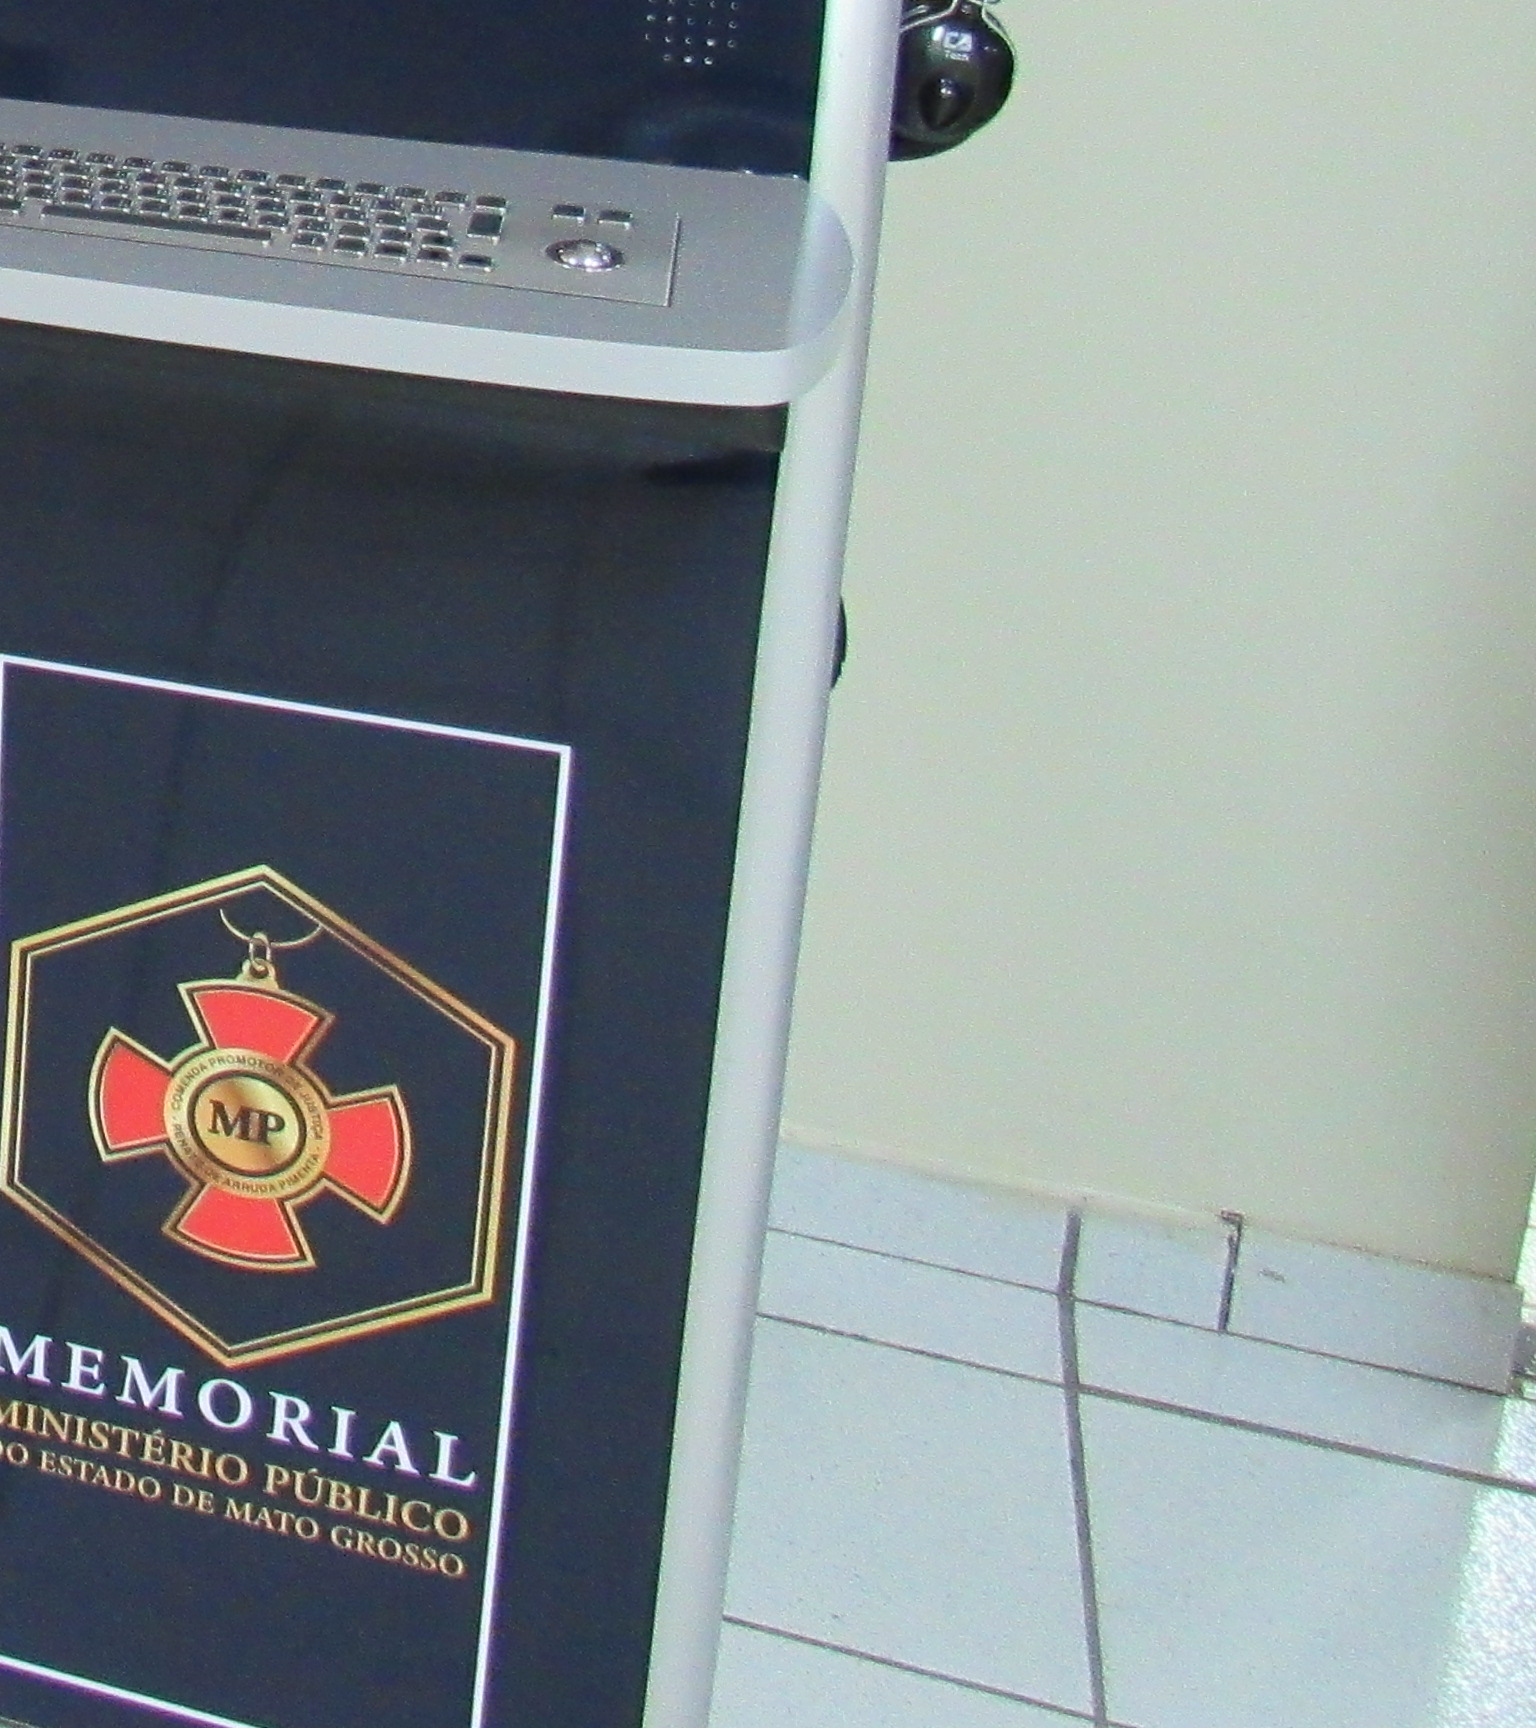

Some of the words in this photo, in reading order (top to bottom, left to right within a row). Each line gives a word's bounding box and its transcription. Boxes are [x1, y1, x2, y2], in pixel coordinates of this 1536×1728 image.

[207, 1099, 285, 1147] MP
[39, 1449, 162, 1499] ESTADO
[172, 1483, 216, 1515] DE
[223, 1497, 321, 1540] MATO
[330, 1525, 466, 1578] GROSSO
[262, 1464, 469, 1540] PÚBLICO
